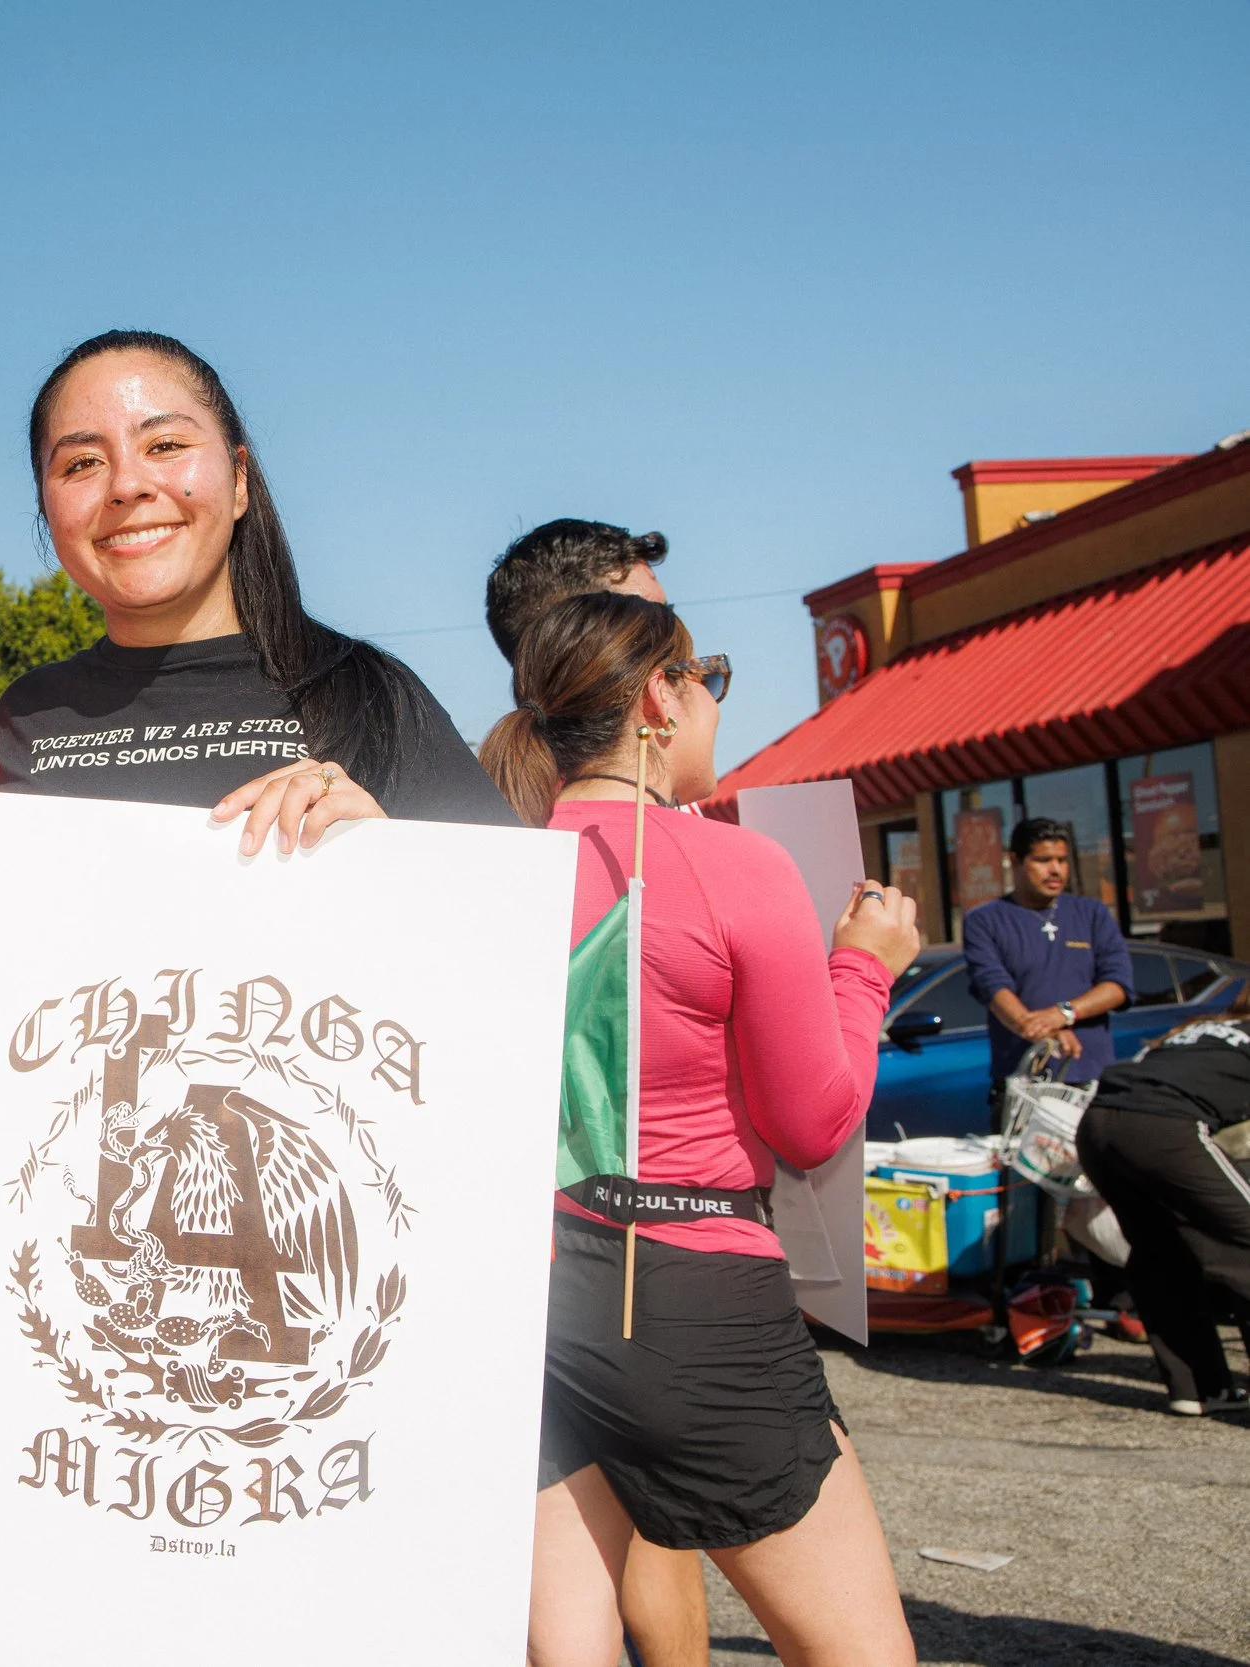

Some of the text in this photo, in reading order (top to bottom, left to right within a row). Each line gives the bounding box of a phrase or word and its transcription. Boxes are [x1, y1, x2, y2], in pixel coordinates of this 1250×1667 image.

[31, 719, 305, 755] TOGETHER WE ARE STRO
[30, 740, 310, 774] JUNTOS SOMOS FUERTES
[8, 967, 427, 1106] CHINGA
[628, 1195, 734, 1215] CULTURE
[18, 1427, 377, 1528] MIGRA
[150, 1535, 236, 1559] Dstroy.la
